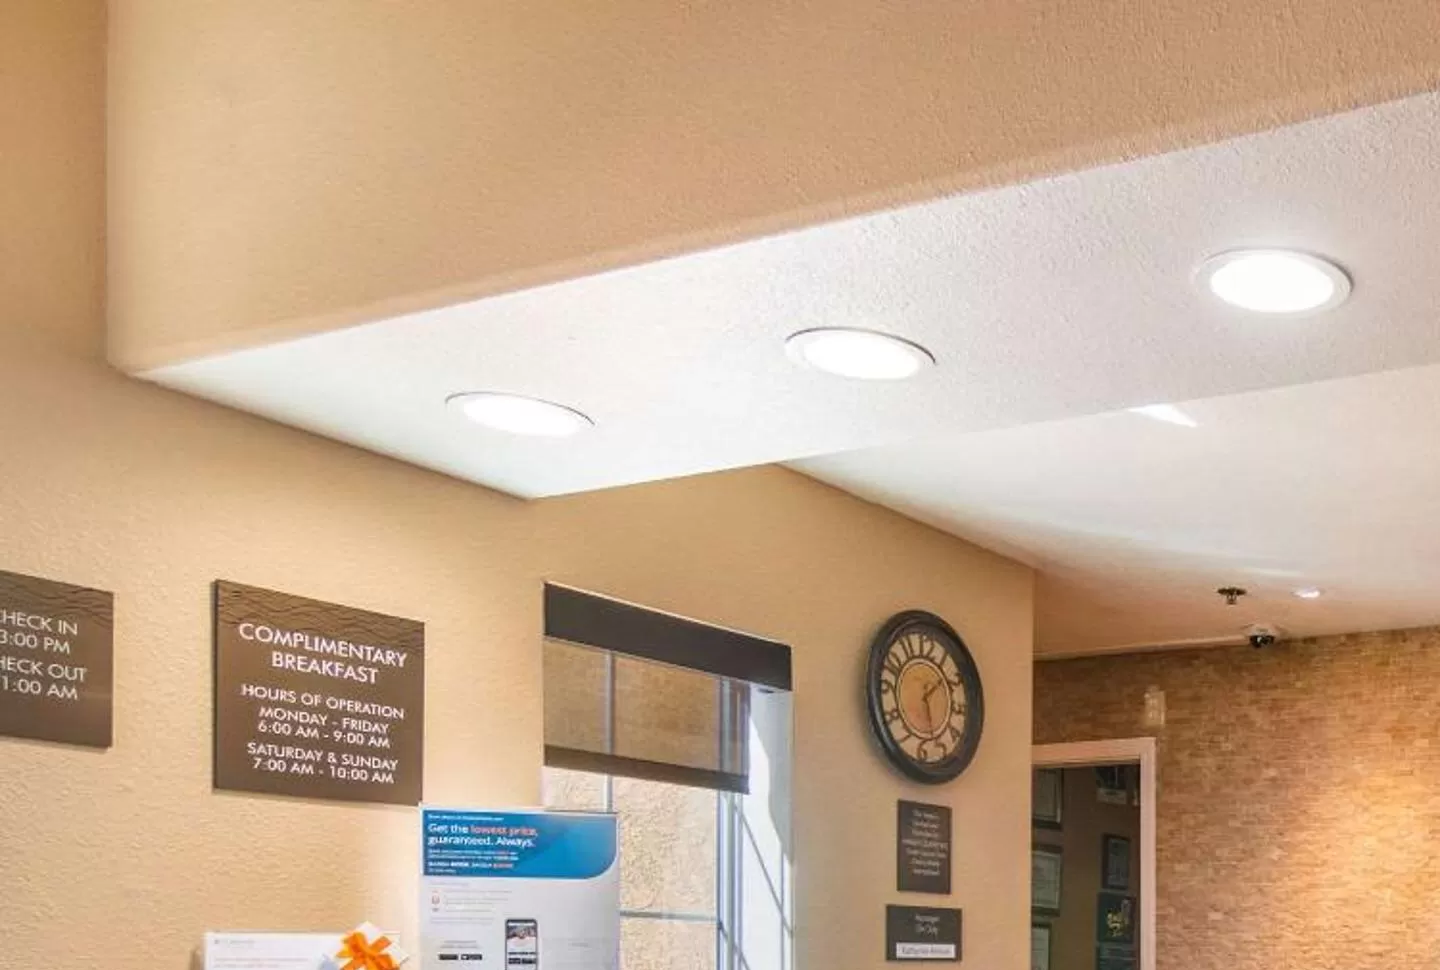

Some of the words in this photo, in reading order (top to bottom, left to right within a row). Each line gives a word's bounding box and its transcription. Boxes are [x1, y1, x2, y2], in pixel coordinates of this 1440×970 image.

[0, 608, 52, 632] HECK
[58, 619, 78, 636] IN
[0, 629, 38, 649] 3:00
[43, 636, 70, 655] PM
[239, 623, 408, 668] COMPLIMENTARY
[47, 663, 88, 682] OUT
[271, 651, 379, 684] BREAKFAST
[47, 683, 78, 700] AM
[241, 683, 297, 704] HOURS
[300, 692, 323, 707] OF
[326, 697, 404, 720] OPERATION
[257, 720, 292, 736] 6:00
[295, 726, 320, 739] AM
[332, 730, 365, 745] 9:00
[368, 737, 390, 749] AM
[258, 706, 328, 726] MONDAY
[342, 717, 389, 735] FRIDAY
[247, 742, 323, 762] SATURDAY
[327, 752, 337, 764] &
[341, 753, 398, 771] SUNDAY
[253, 757, 287, 772] 7:00
[290, 763, 314, 775] AM
[330, 766, 368, 780] 10:00
[371, 771, 394, 784] AM
[428, 823, 448, 834] Get
[450, 824, 469, 834] the
